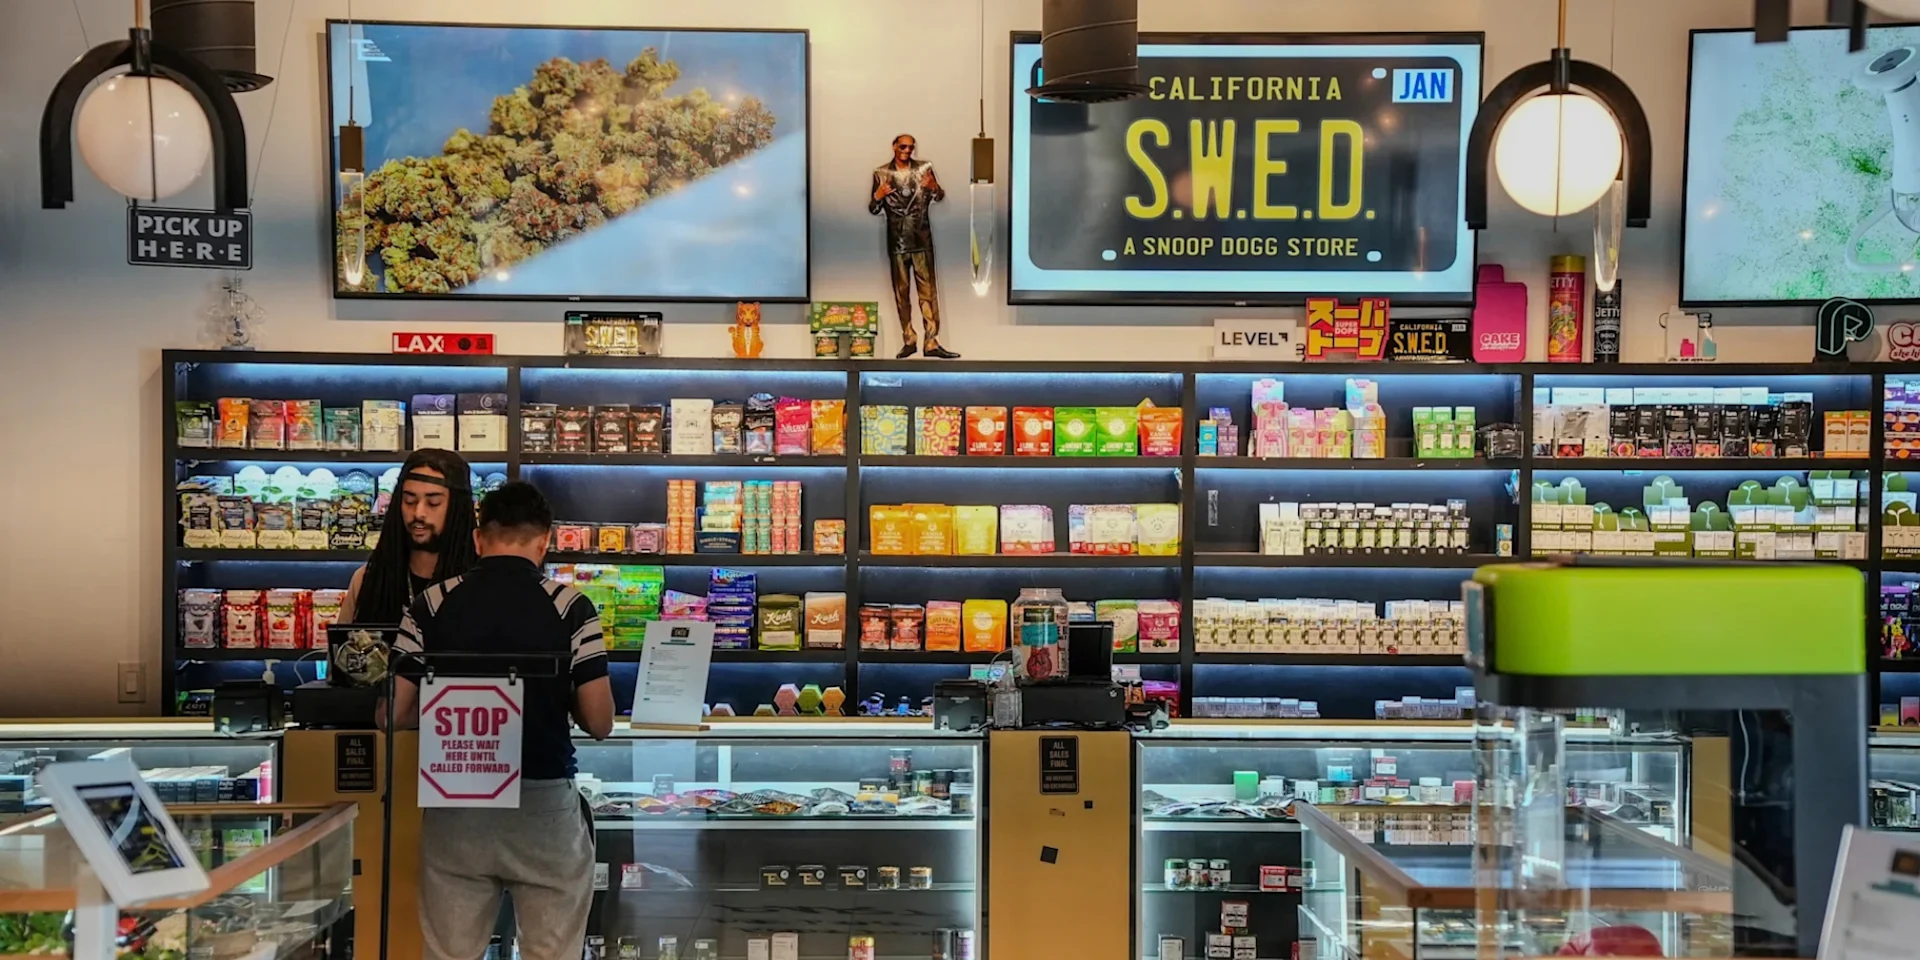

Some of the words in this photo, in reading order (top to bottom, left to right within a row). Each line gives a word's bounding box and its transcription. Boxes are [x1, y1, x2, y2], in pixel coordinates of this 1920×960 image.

[1149, 76, 1342, 101] CALIFORNIA
[1398, 71, 1447, 99] JAN
[1125, 118, 1376, 219] S.W.E.D.
[137, 215, 200, 235] PICK
[208, 218, 243, 238] UP
[1123, 238, 1136, 255] A
[1143, 237, 1214, 256] SNOOP
[1221, 237, 1278, 256] DOGG
[1288, 238, 1359, 257] STORE
[1549, 276, 1575, 289] ETTY
[393, 334, 445, 353] LAX
[1221, 332, 1279, 346] LEVEL
[1481, 334, 1519, 344] CAKE
[764, 609, 792, 625] Kush
[811, 609, 840, 625] Kush
[435, 706, 508, 737] STOP
[350, 738, 362, 747] ALL
[441, 740, 474, 750] PLEASE
[476, 740, 500, 750] WAIT
[1053, 741, 1065, 750] ALL
[345, 747, 367, 756] SALES
[445, 752, 469, 761] HERE
[470, 752, 496, 761] UNTIL
[1049, 750, 1070, 759] SALES
[430, 763, 463, 773] CALLED
[465, 764, 510, 773] FORWARD
[1050, 759, 1069, 768] FINAL
